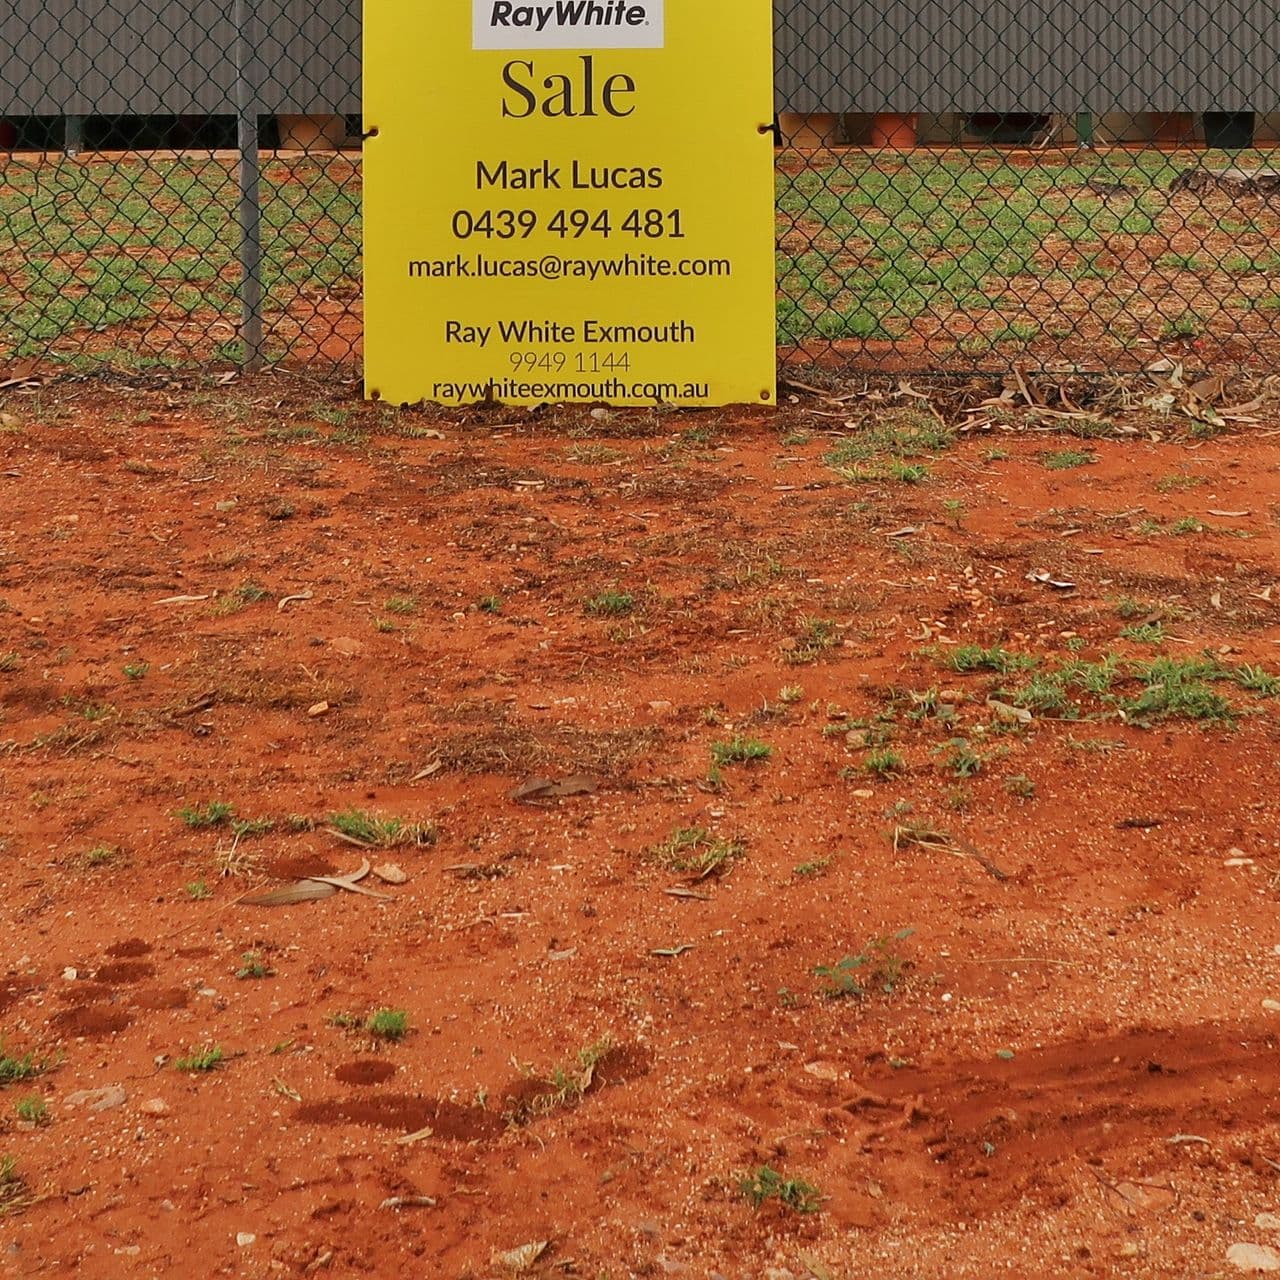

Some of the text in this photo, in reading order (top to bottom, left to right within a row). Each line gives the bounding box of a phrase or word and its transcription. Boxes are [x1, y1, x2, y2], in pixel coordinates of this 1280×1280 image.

[502, 55, 636, 119] Sale
[475, 160, 663, 189] Mark Lucas
[451, 209, 685, 239] 0439 494 481
[408, 254, 731, 281] mark.lucas@raywhite.com
[445, 320, 695, 348] Ray White Exmouth
[509, 351, 631, 373] 9949 1144
[432, 377, 709, 402] raywhiteexmouth.com.au
